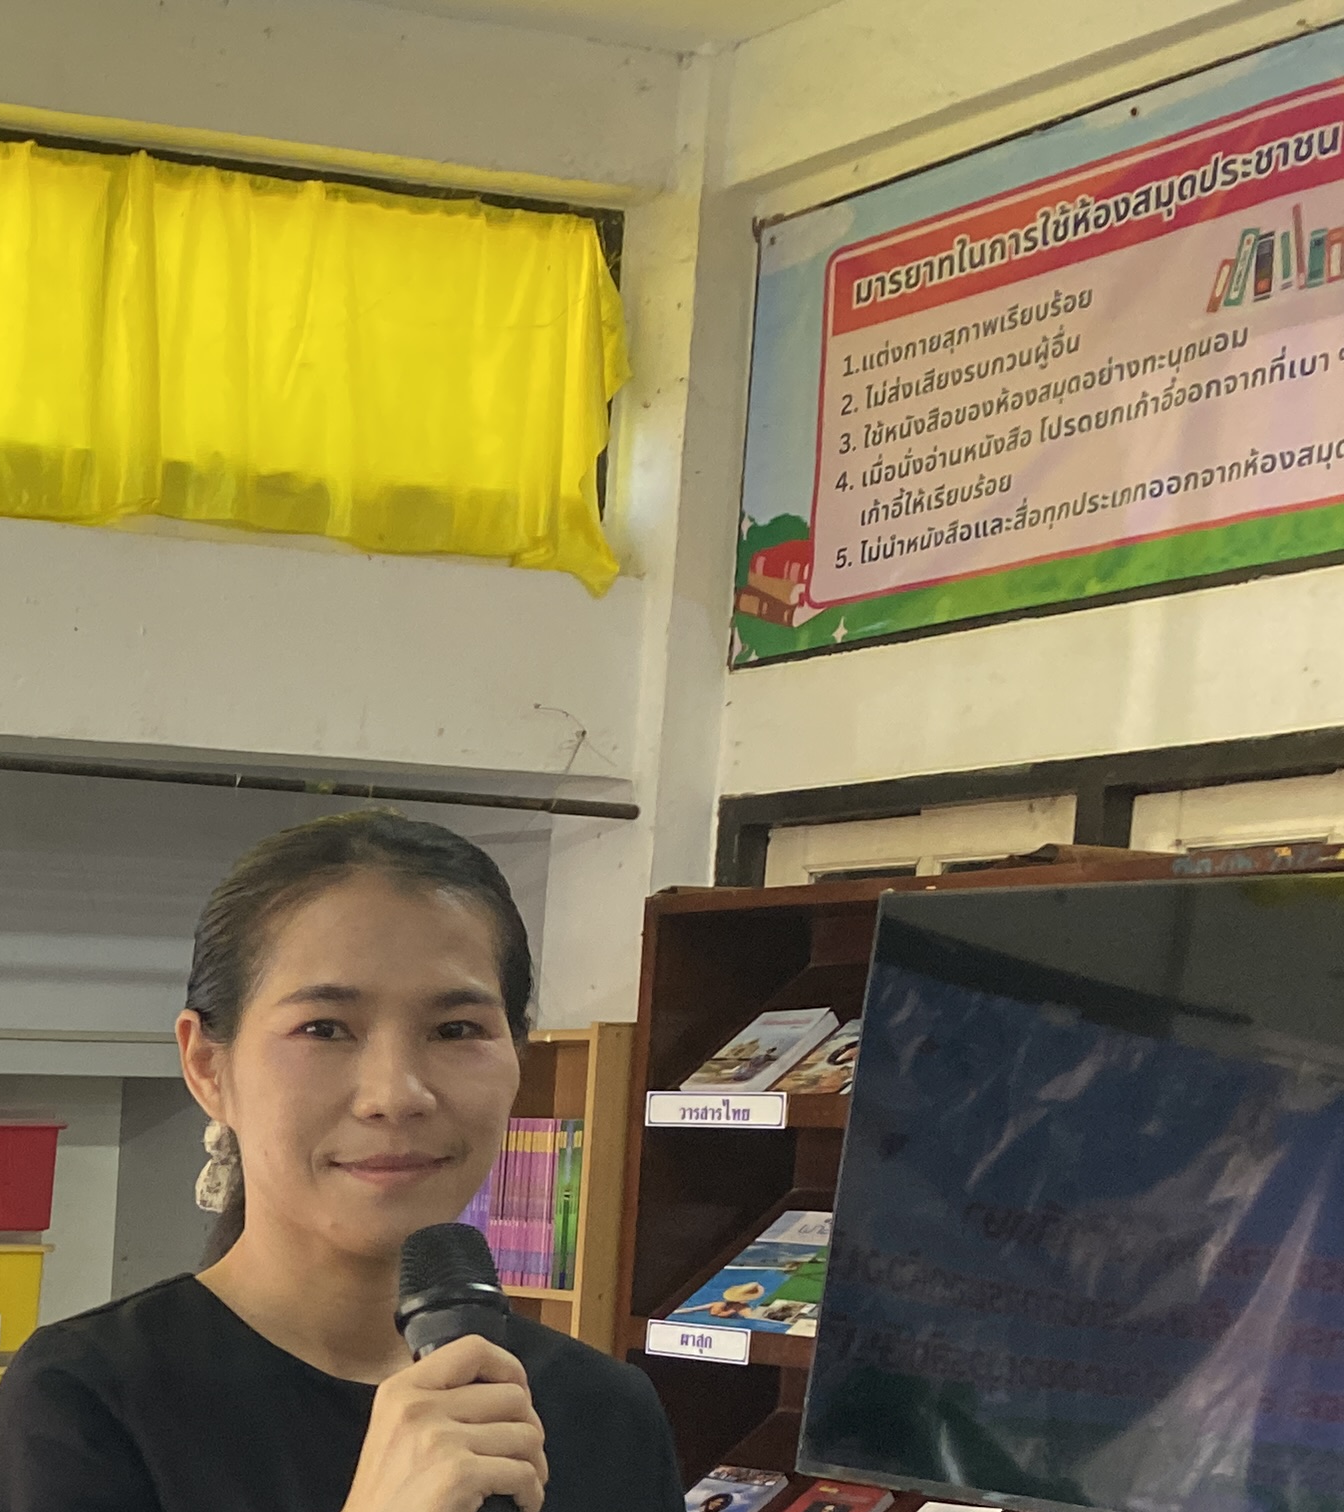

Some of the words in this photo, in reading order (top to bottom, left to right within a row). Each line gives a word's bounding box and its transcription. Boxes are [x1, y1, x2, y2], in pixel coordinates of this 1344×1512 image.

[853, 123, 1342, 306] มารยาทในการใช้ห้องสมุดประชาชน
[842, 289, 1093, 377] 1.แต่งกายสุภาพเรียบร้อย
[838, 433, 857, 455] 3.
[864, 327, 1249, 449] ใช้หนังสือของห้องสมุดอย่างทะนุถนอม
[840, 395, 859, 416] 2.
[865, 324, 1081, 410] ไม่ส่งเสียงรบกวนผู้อื่น
[835, 471, 854, 493] 4.
[861, 427, 1032, 488] เมื่อนั่งอ่านหนังสือ
[860, 474, 1012, 526] เก้าอี้ให้เรียบร้อย
[835, 547, 853, 569] 5.
[679, 1099, 750, 1121] วารสารไทย
[680, 1331, 713, 1354] ผาสุก
